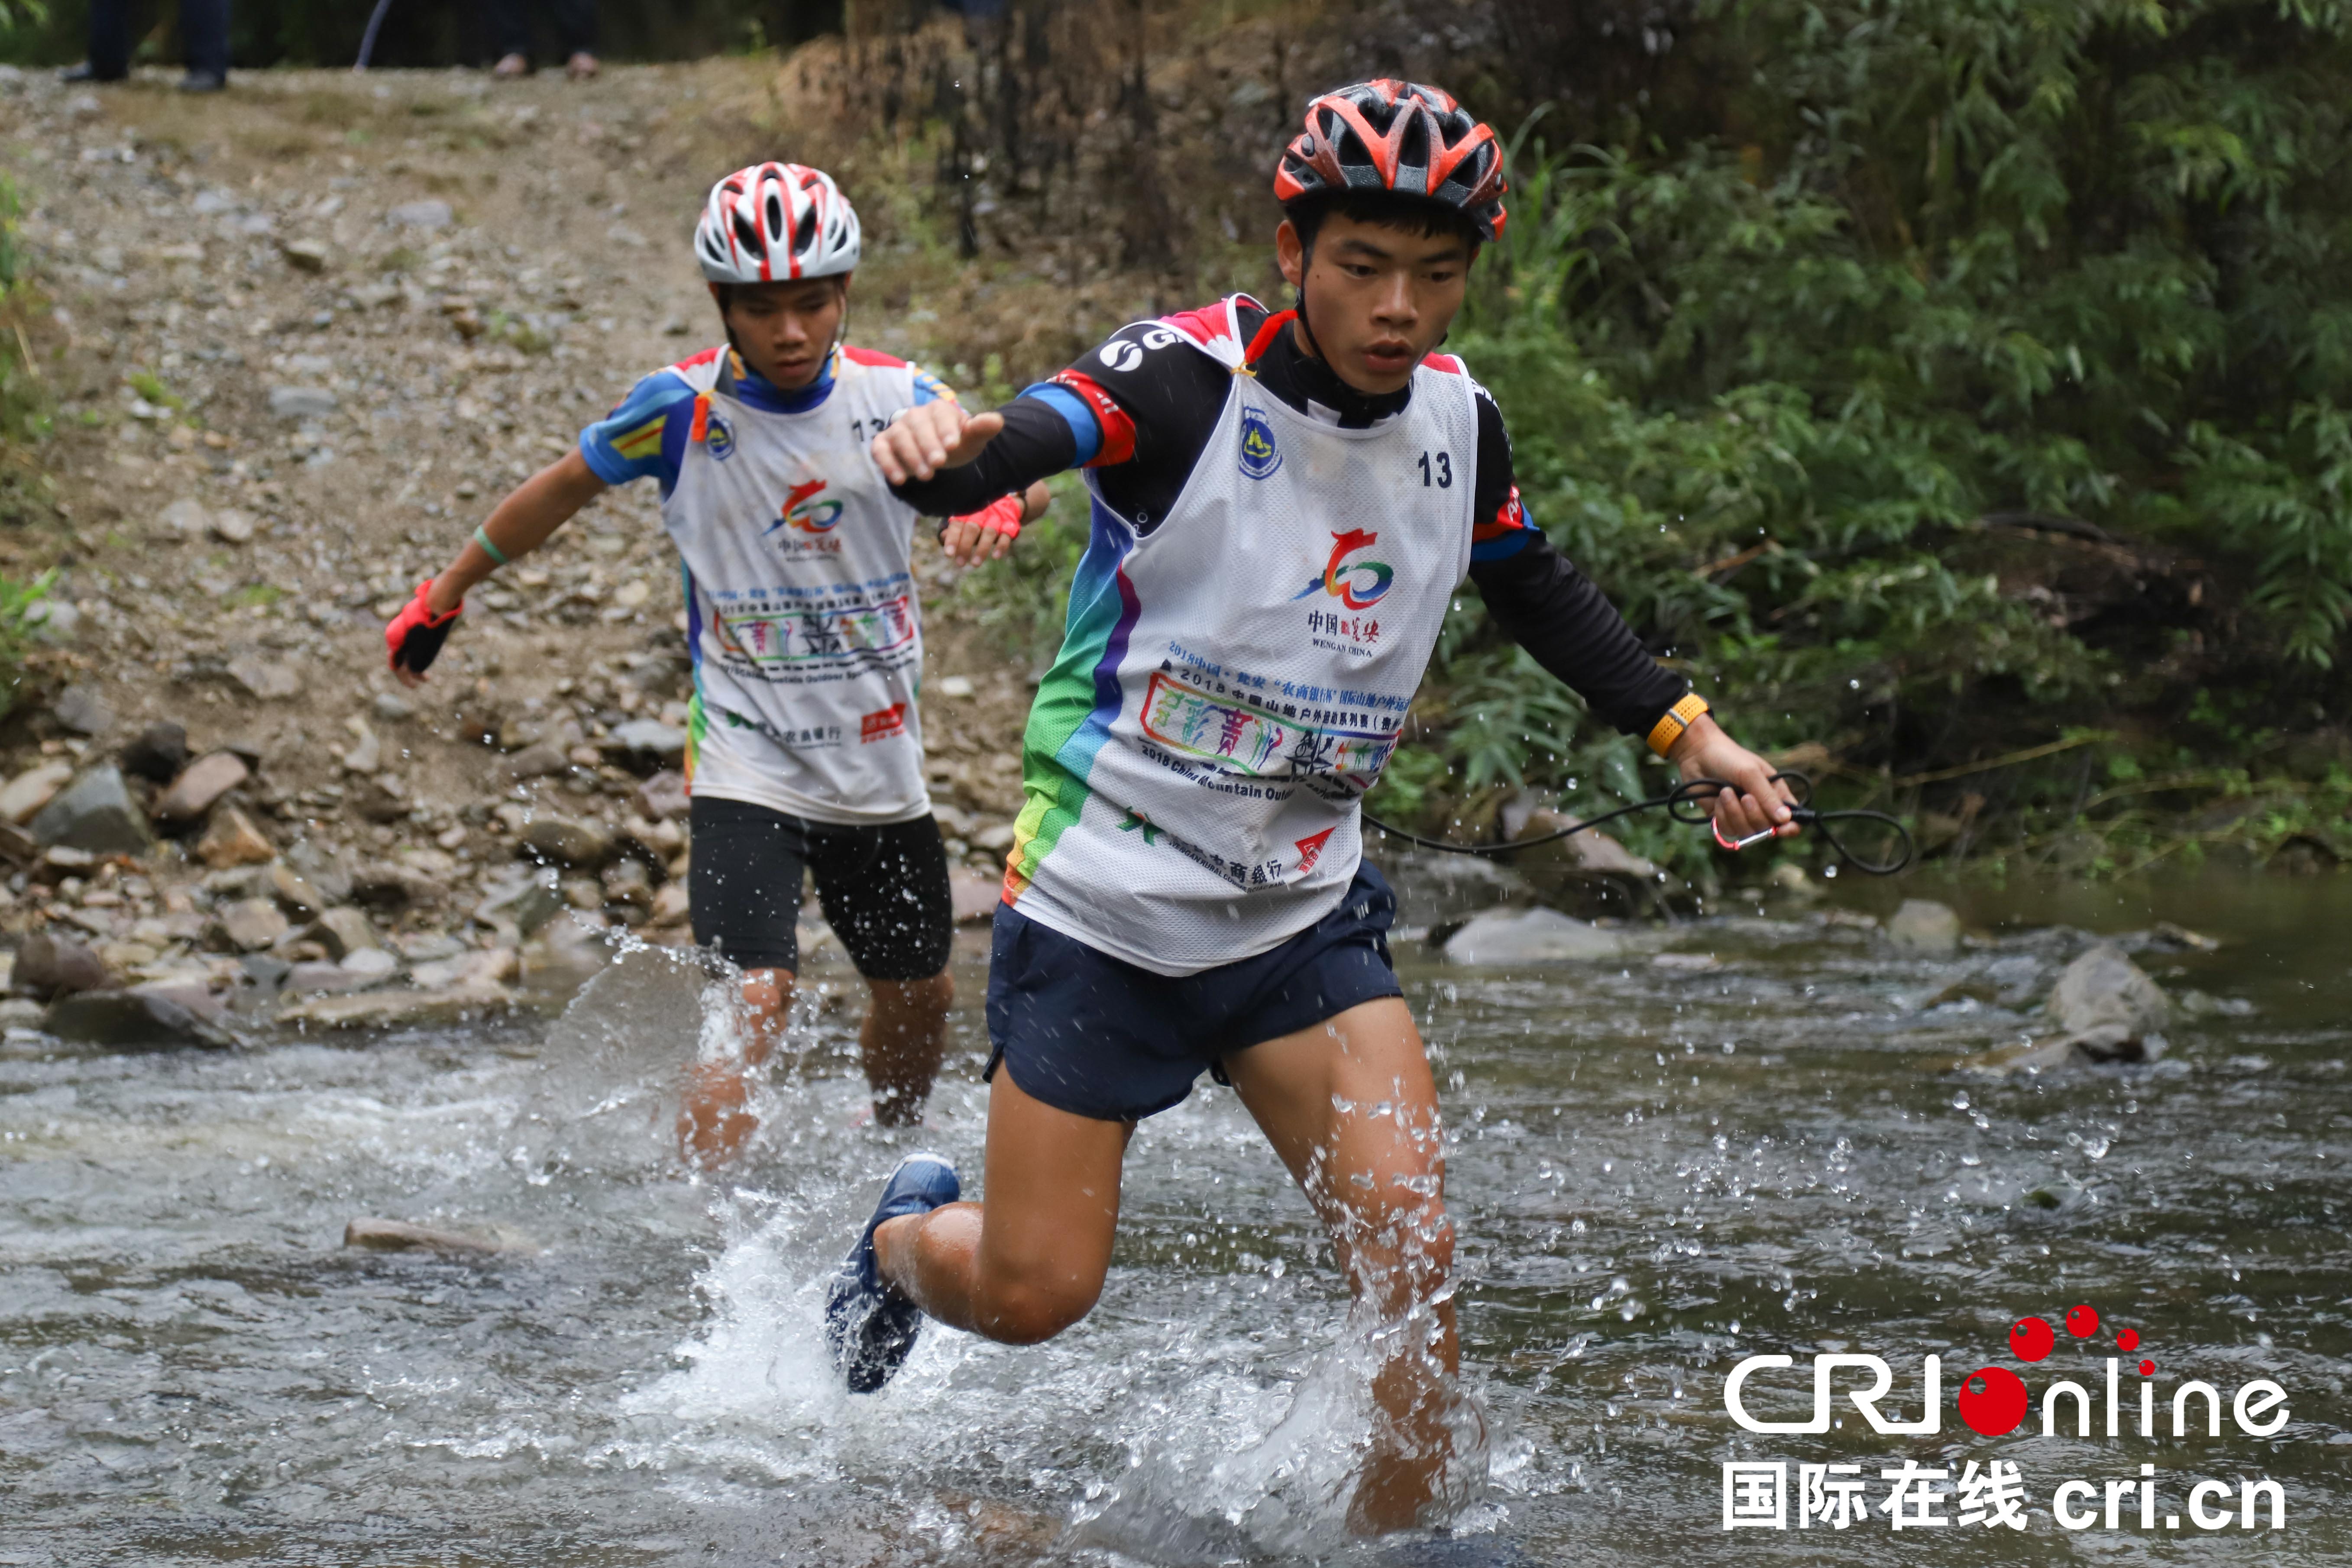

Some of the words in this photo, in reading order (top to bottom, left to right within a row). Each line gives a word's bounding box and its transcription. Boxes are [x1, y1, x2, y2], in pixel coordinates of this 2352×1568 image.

[1418, 451, 1452, 488] 13
[1313, 638, 1346, 652] WENGAN
[1349, 646, 1372, 657] CHINA
[1142, 745, 1169, 767] 2018
[1171, 761, 1200, 782] China
[1197, 775, 1262, 798] Mountain
